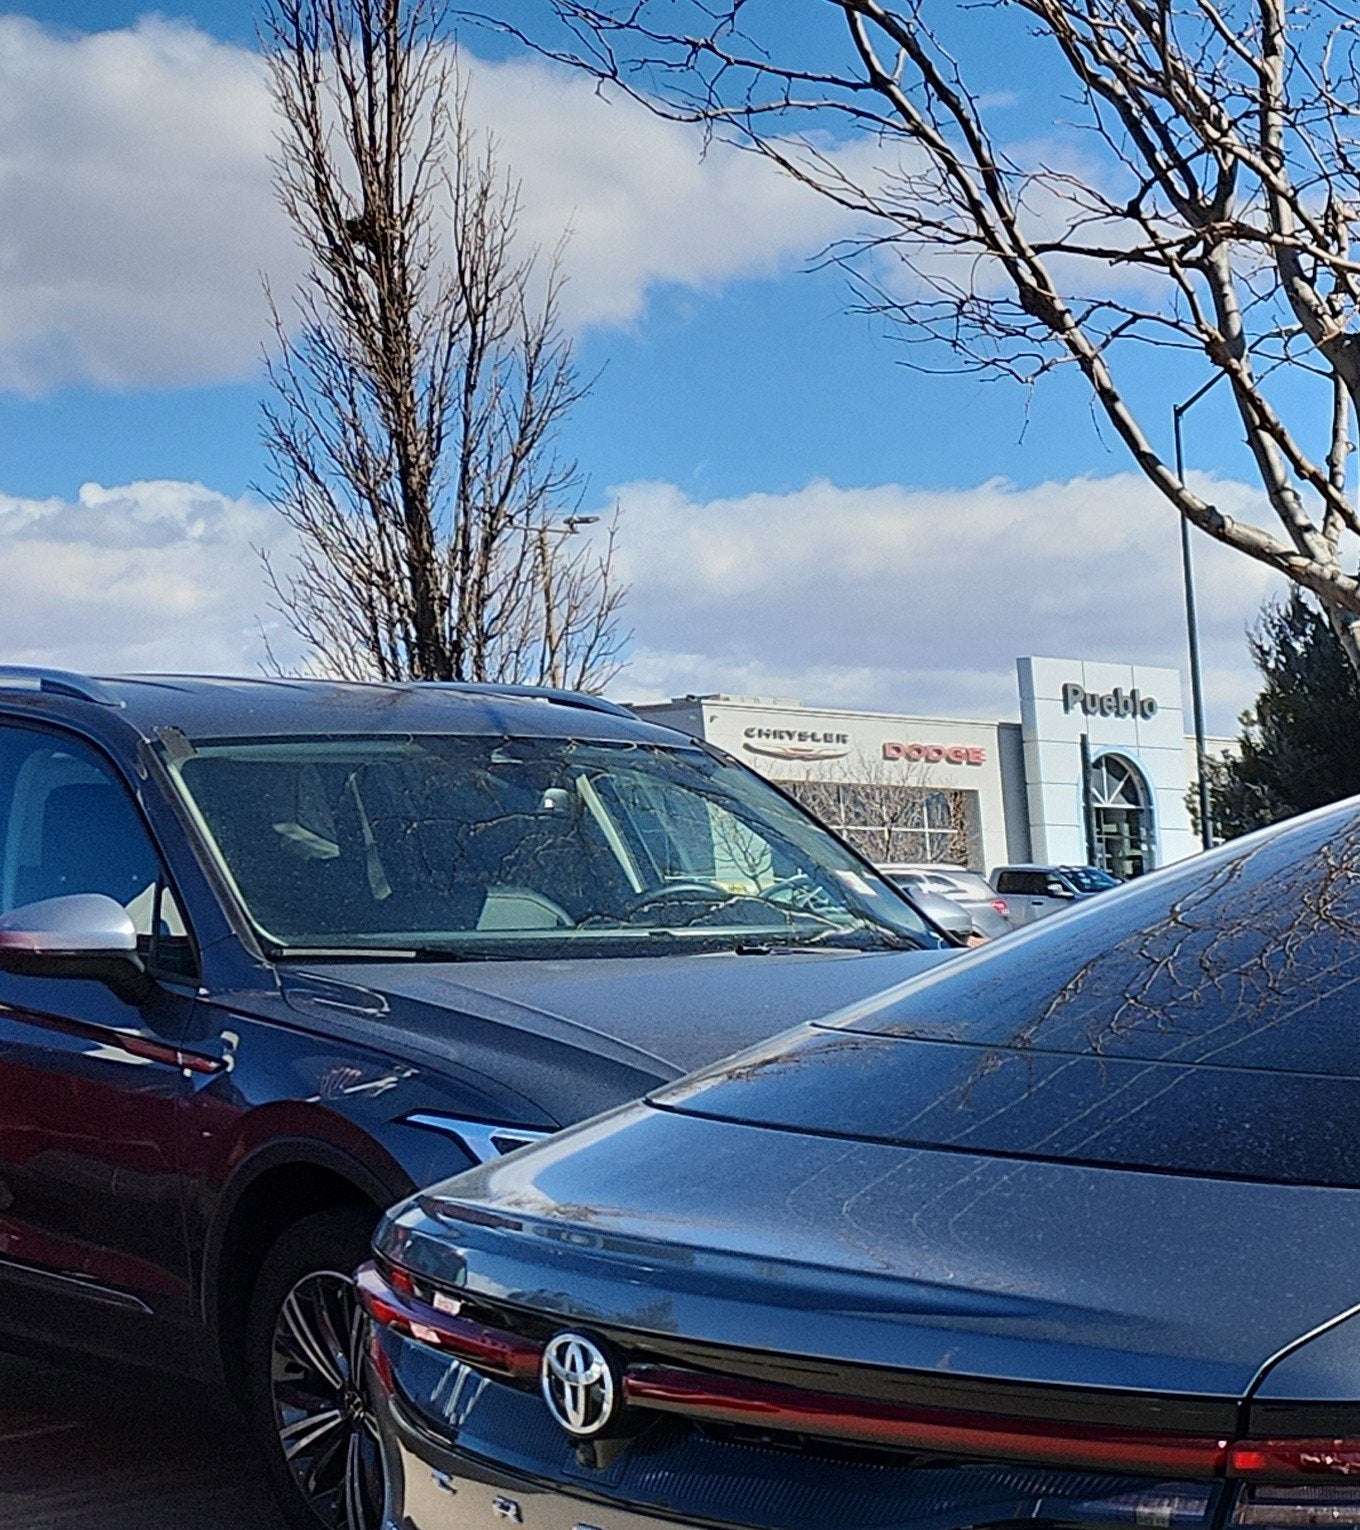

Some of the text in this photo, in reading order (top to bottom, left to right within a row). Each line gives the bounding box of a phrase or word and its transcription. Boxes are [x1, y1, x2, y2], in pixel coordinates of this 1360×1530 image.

[1062, 682, 1158, 720] Pueblo
[743, 727, 850, 745] CHRYSLER
[881, 742, 988, 765] DODGE
